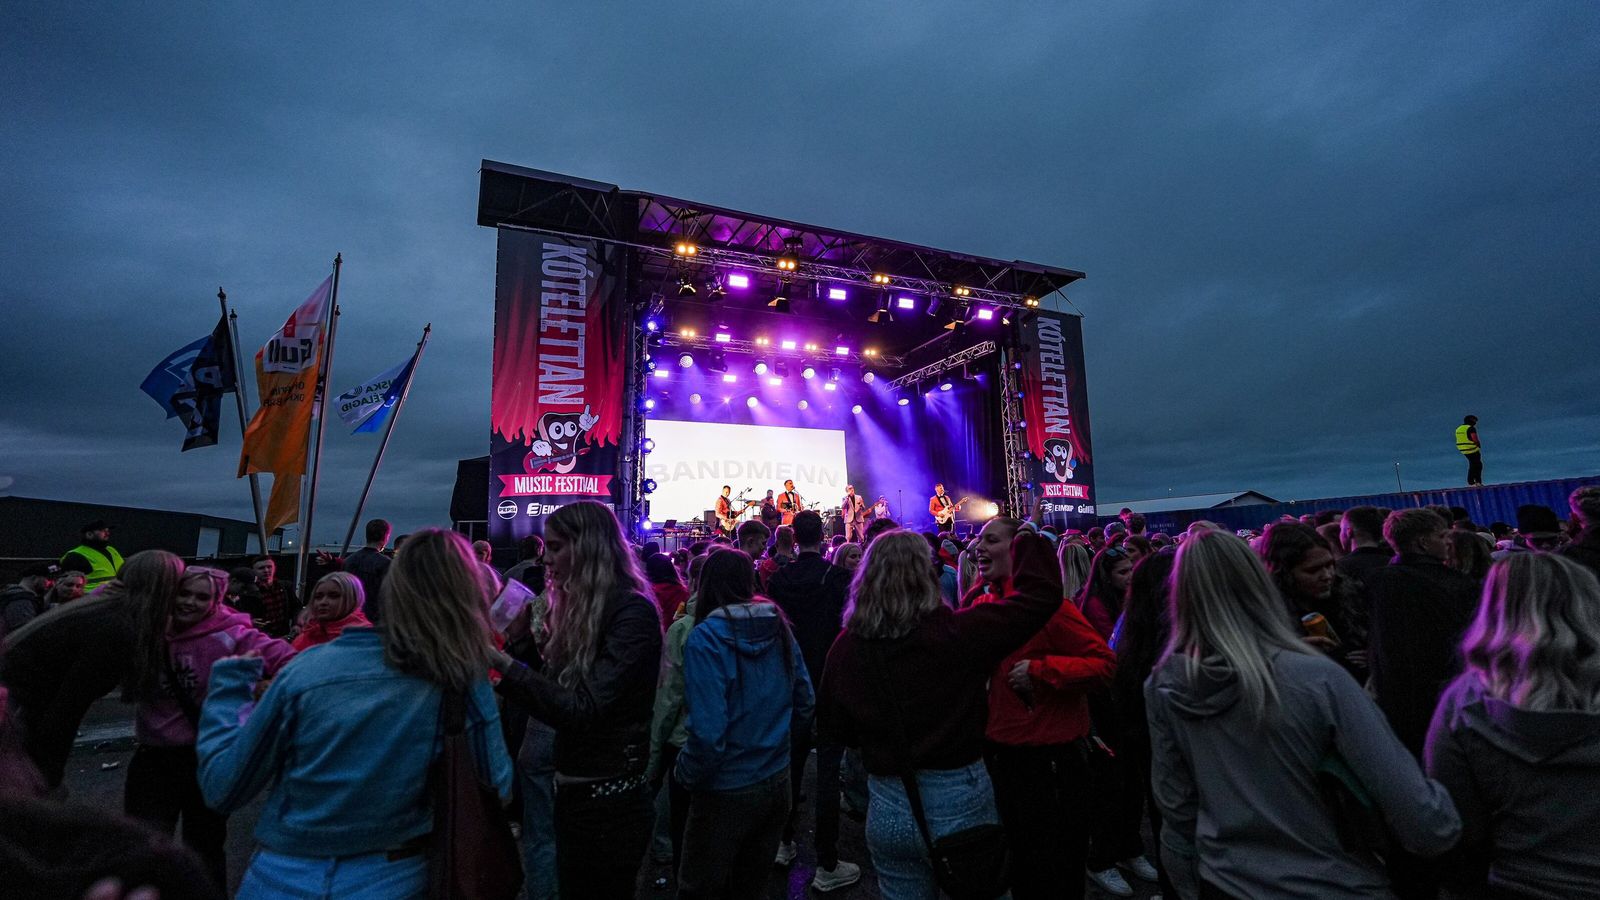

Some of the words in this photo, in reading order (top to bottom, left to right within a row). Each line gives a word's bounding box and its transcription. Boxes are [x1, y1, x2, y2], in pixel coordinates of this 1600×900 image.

[538, 242, 594, 405] KÓTELETTAN
[1037, 316, 1071, 434] KÓTELETTAN
[514, 476, 553, 493] MUSIC
[554, 476, 599, 493] FESTIVAL
[648, 460, 839, 487] BANDMENN
